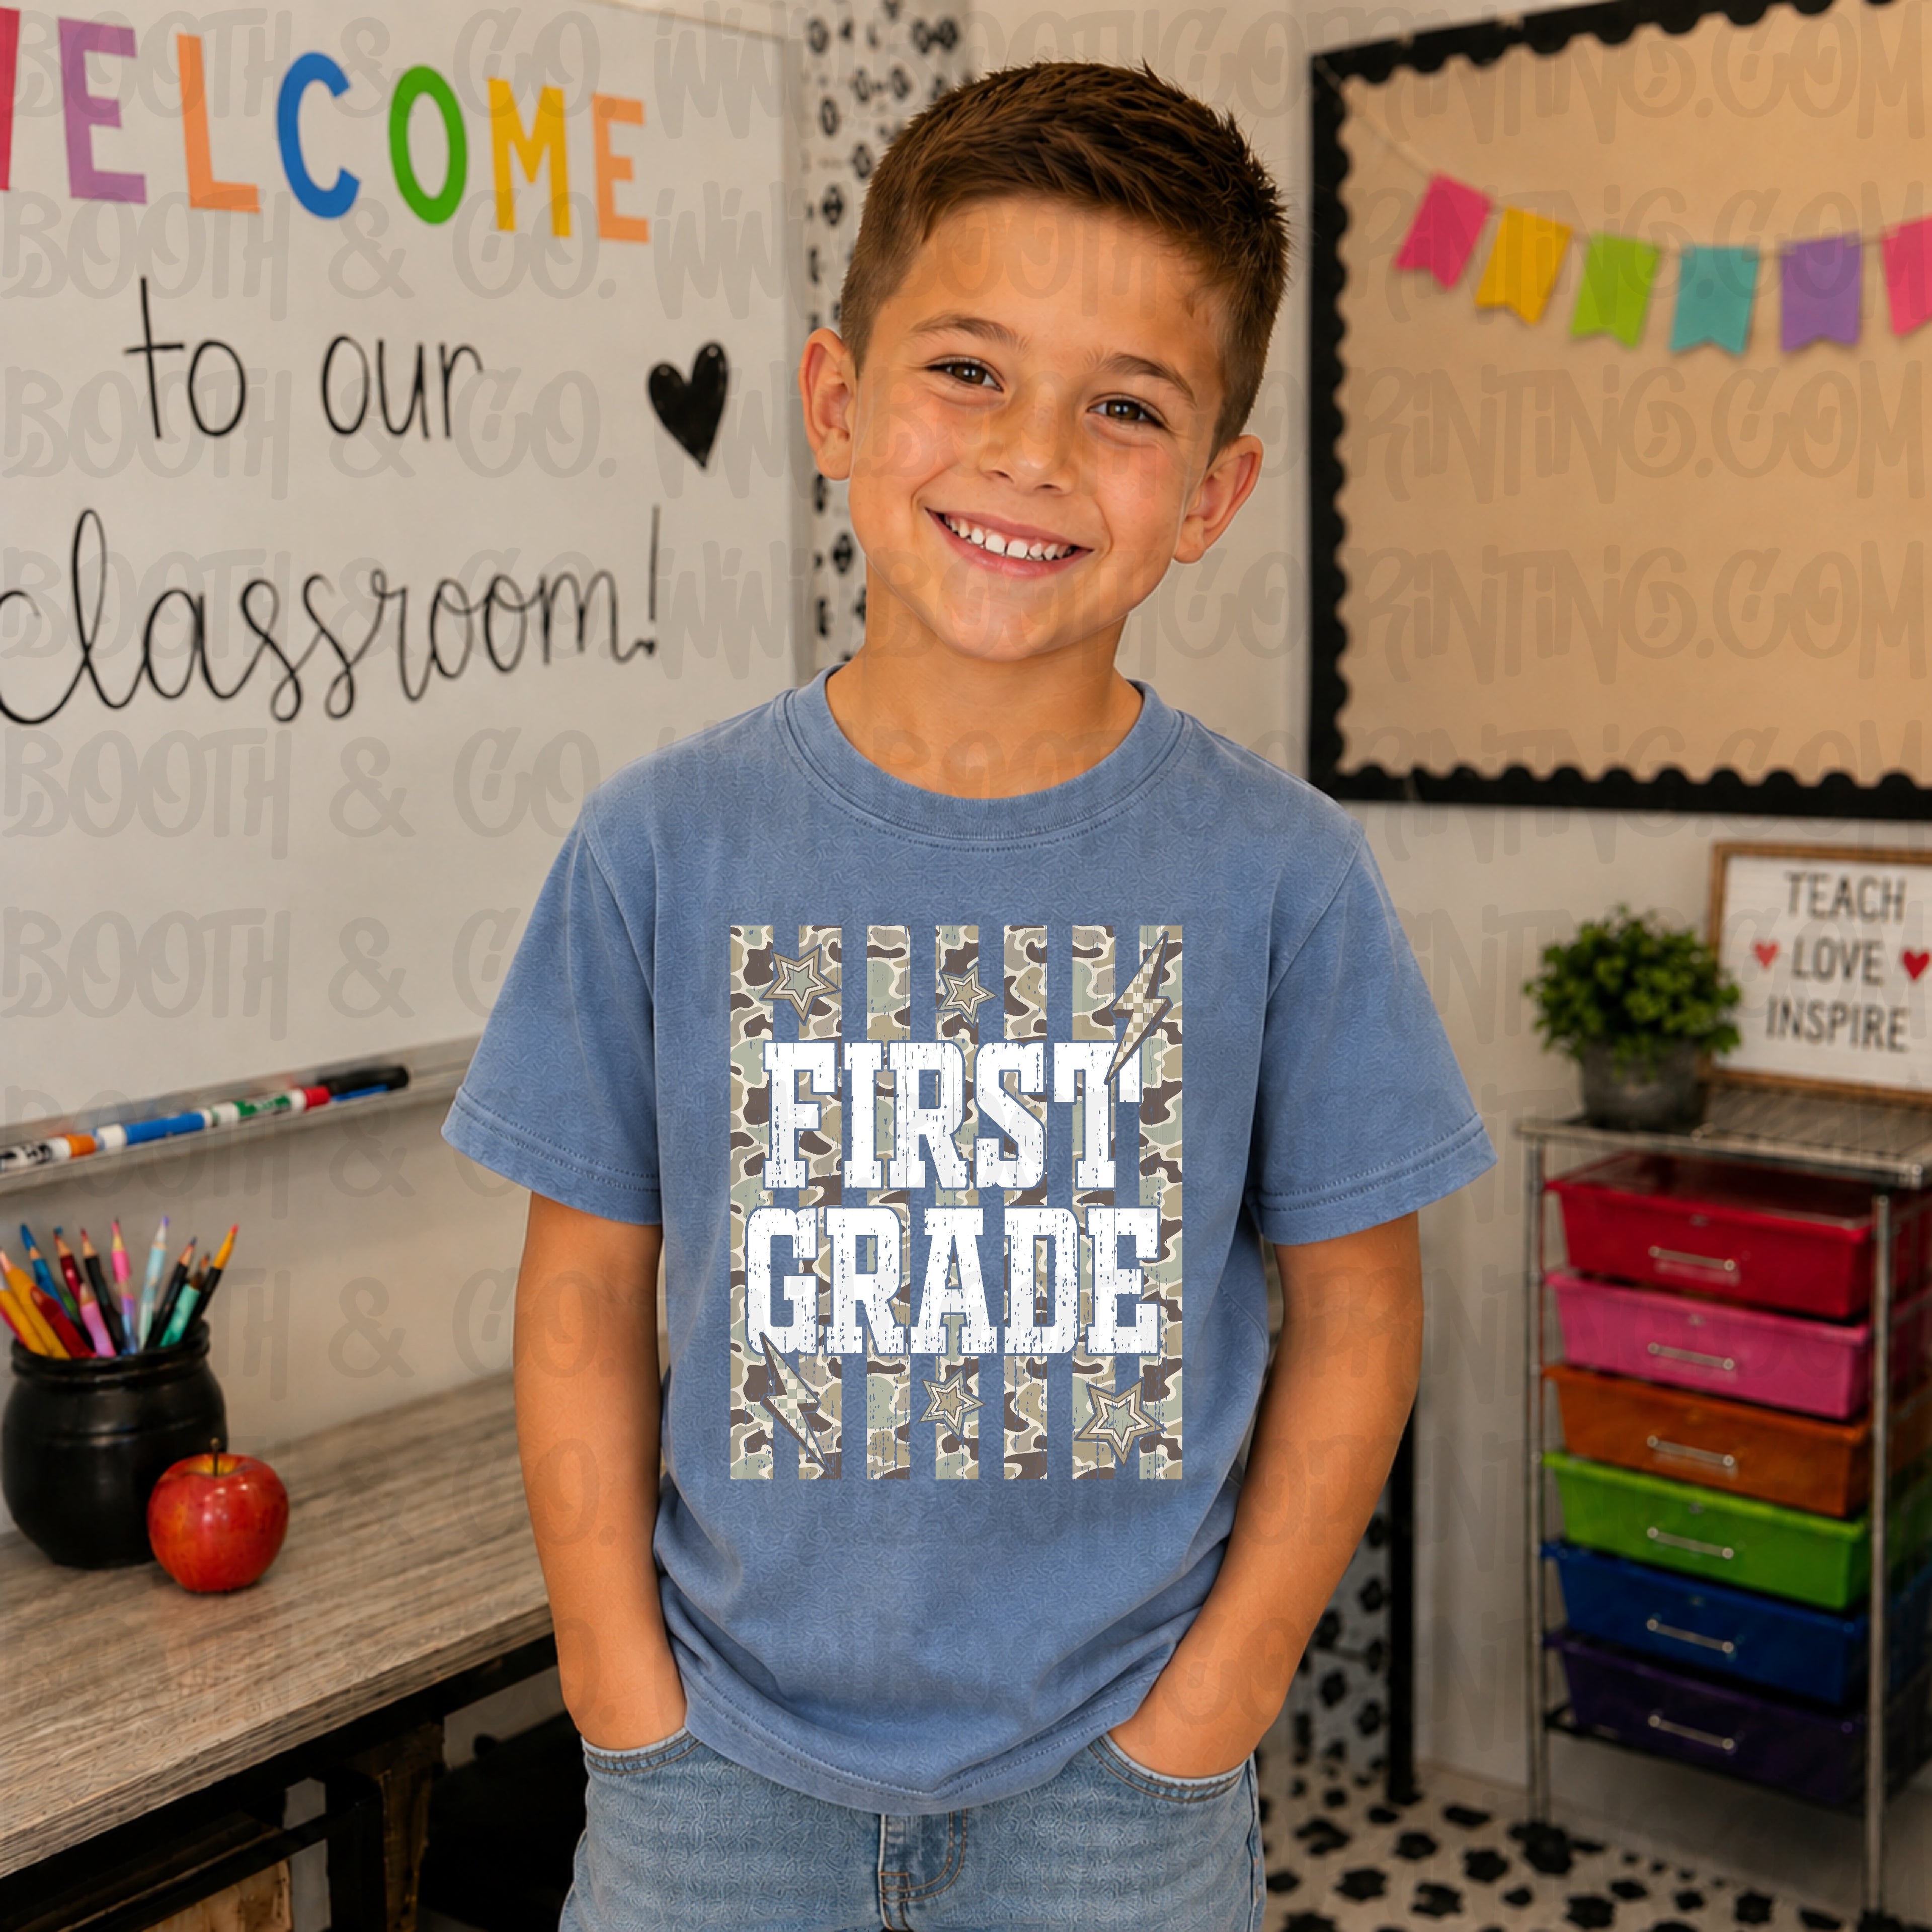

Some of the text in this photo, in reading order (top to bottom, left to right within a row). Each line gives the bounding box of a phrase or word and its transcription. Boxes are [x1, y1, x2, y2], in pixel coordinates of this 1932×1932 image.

[0, 8, 651, 245] ELCOME
[122, 275, 483, 440] to our
[0, 504, 658, 723] classroom!
[1785, 870, 1906, 924] TEACH
[1791, 936, 1885, 986] LOVE
[1765, 993, 1911, 1053] INSPIRE
[763, 1040, 1142, 1188] FIRST
[746, 1206, 1160, 1354] GRADE
